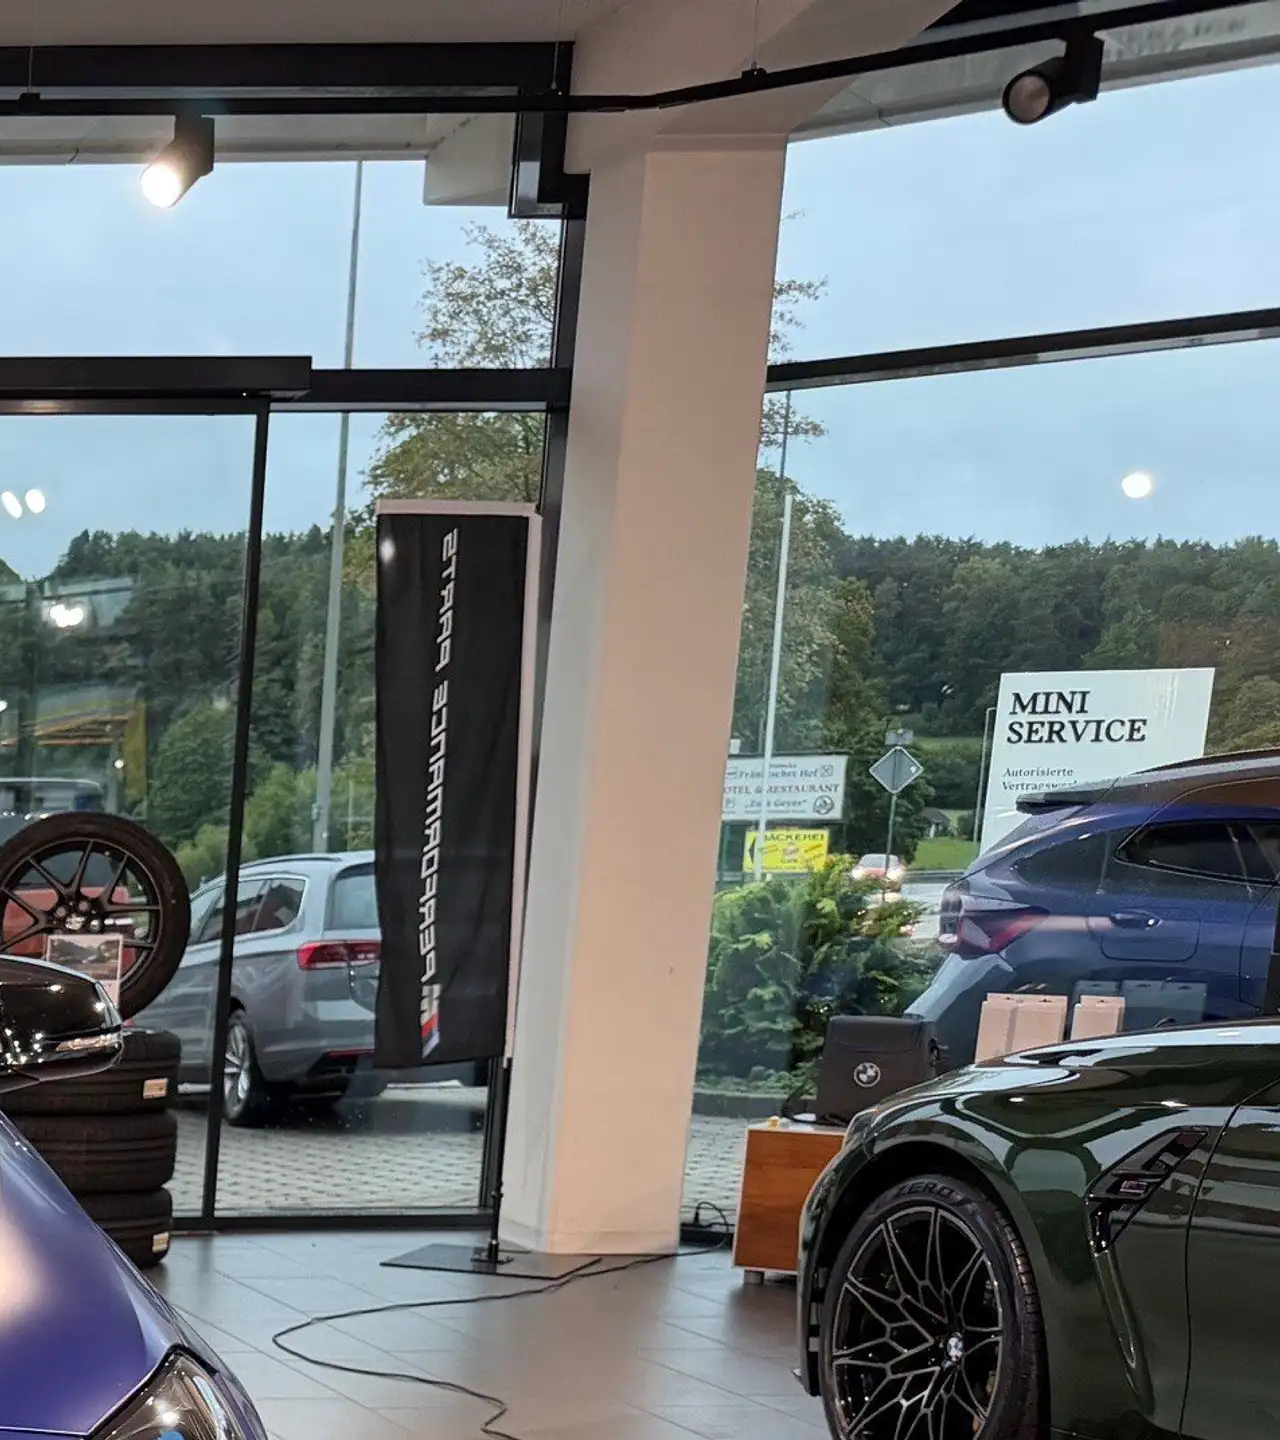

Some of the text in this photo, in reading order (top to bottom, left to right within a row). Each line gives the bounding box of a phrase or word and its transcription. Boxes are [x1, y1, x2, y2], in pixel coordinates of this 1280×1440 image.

[1008, 690, 1091, 716] MINI
[1006, 717, 1148, 744] SERVICE
[1002, 766, 1074, 778] Autorisierte
